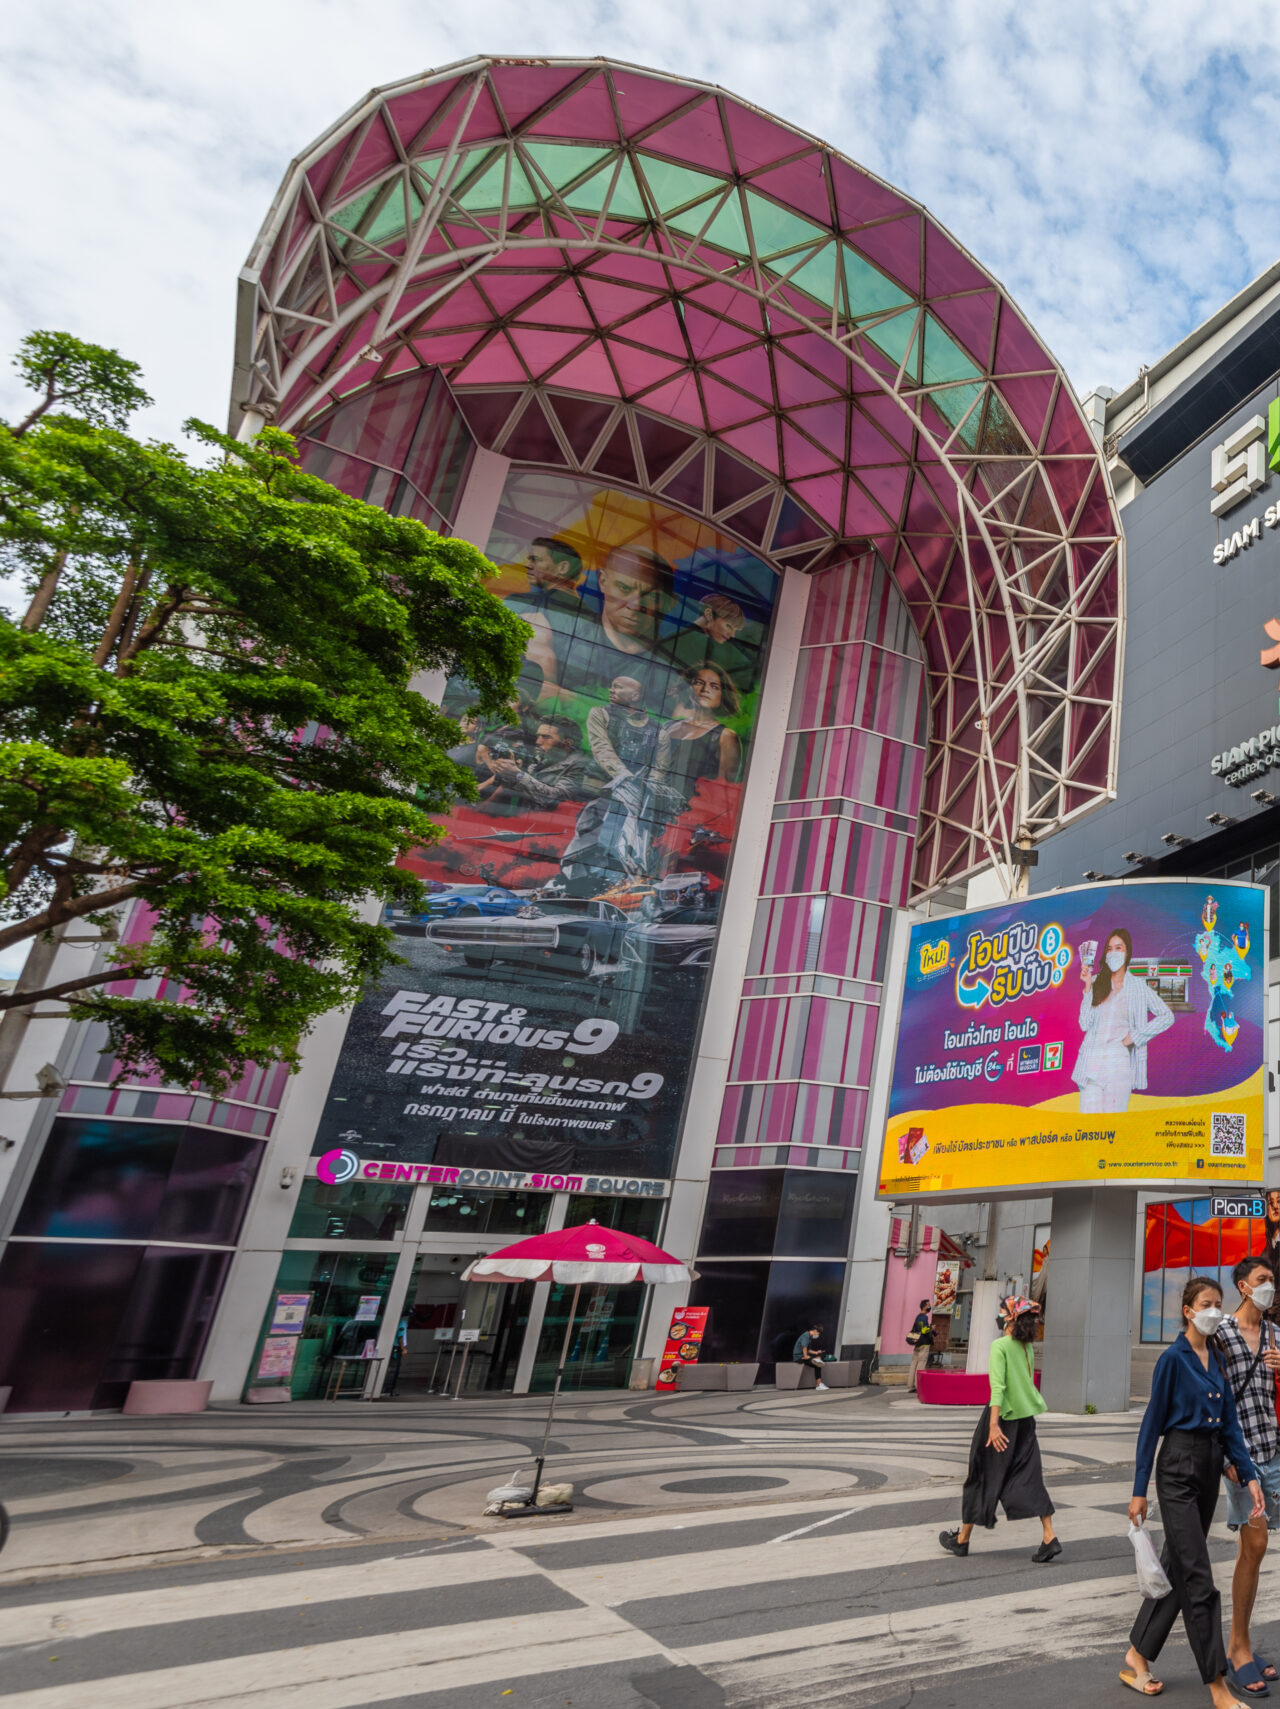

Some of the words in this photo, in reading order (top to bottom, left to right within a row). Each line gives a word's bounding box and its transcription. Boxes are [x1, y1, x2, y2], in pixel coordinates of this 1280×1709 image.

[1213, 517, 1260, 563] SIAM
[1210, 738, 1258, 776] SIAM
[1224, 758, 1265, 787] center
[944, 1021, 1001, 1050] โอนทั่วไทย
[1004, 1018, 1038, 1041] โอนไว
[403, 1102, 496, 1122] กรกฎาคม
[531, 1174, 583, 1191] SIAM
[585, 1177, 665, 1196] SQUARE
